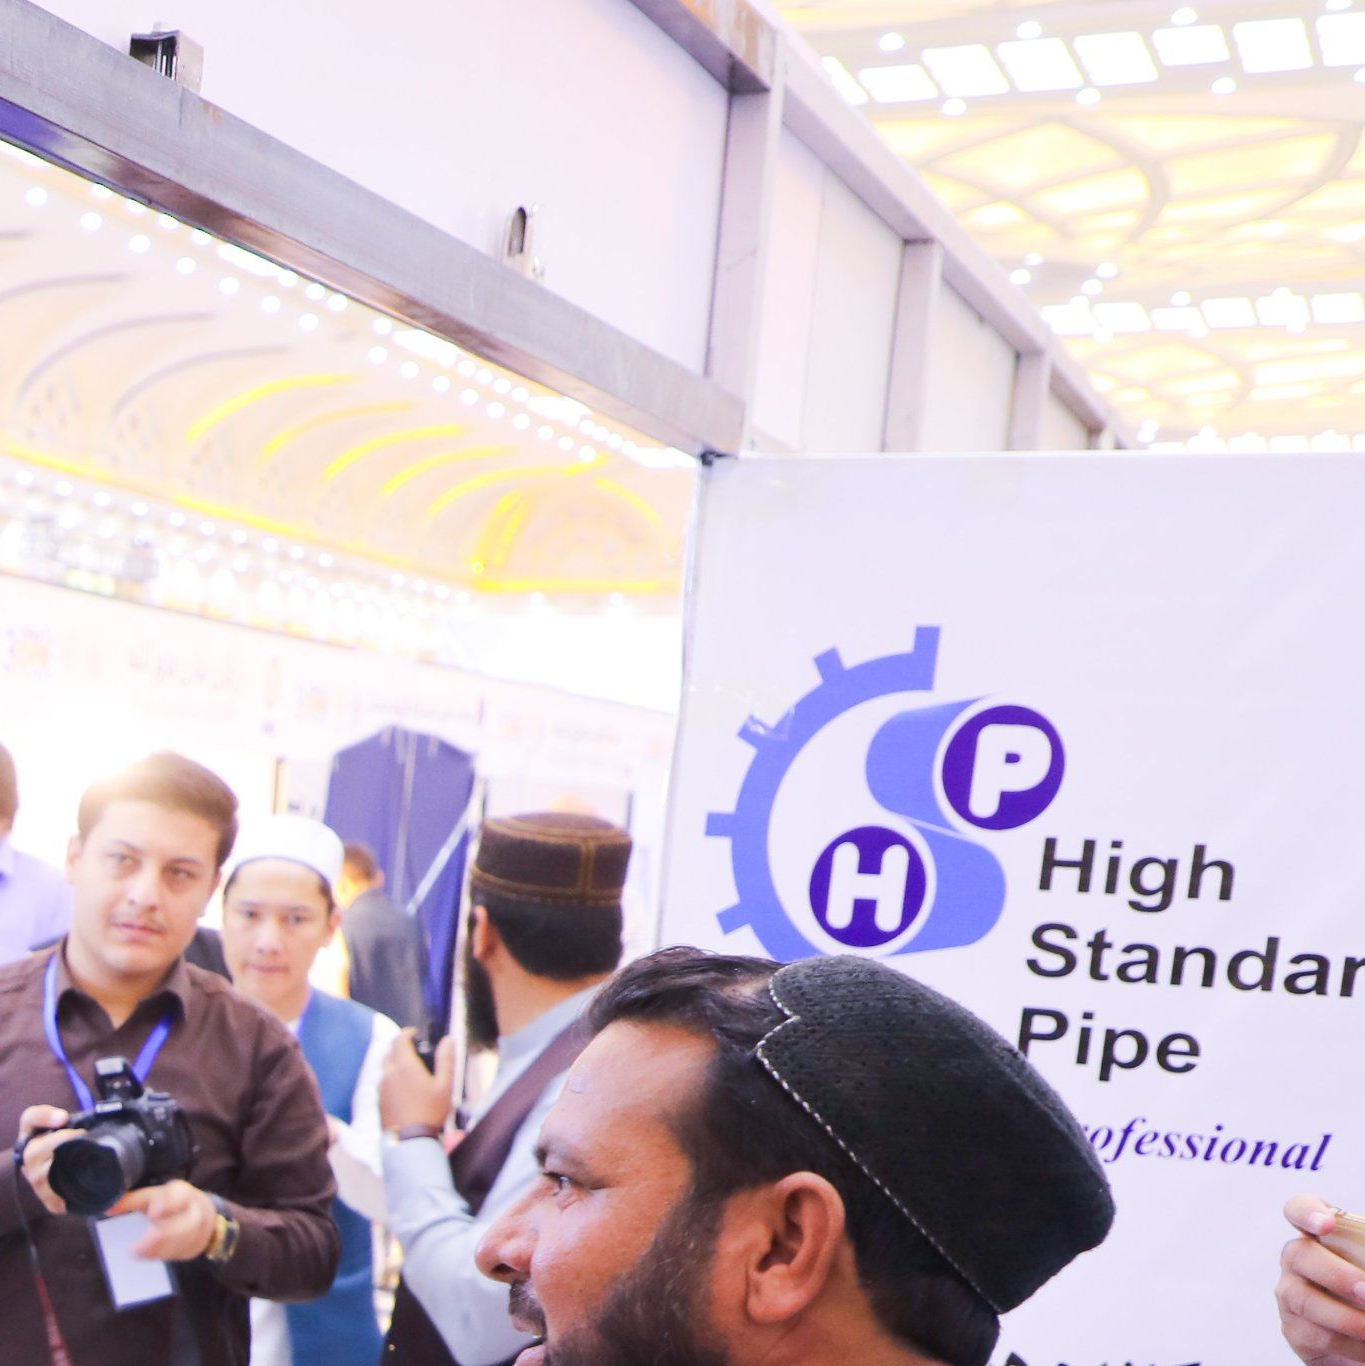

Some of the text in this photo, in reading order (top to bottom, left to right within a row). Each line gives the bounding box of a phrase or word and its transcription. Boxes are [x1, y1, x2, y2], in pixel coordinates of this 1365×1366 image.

[1038, 837, 1236, 913] High
[1017, 1006, 1201, 1083] Pipe
[1083, 1115, 1334, 1172] ofessional
